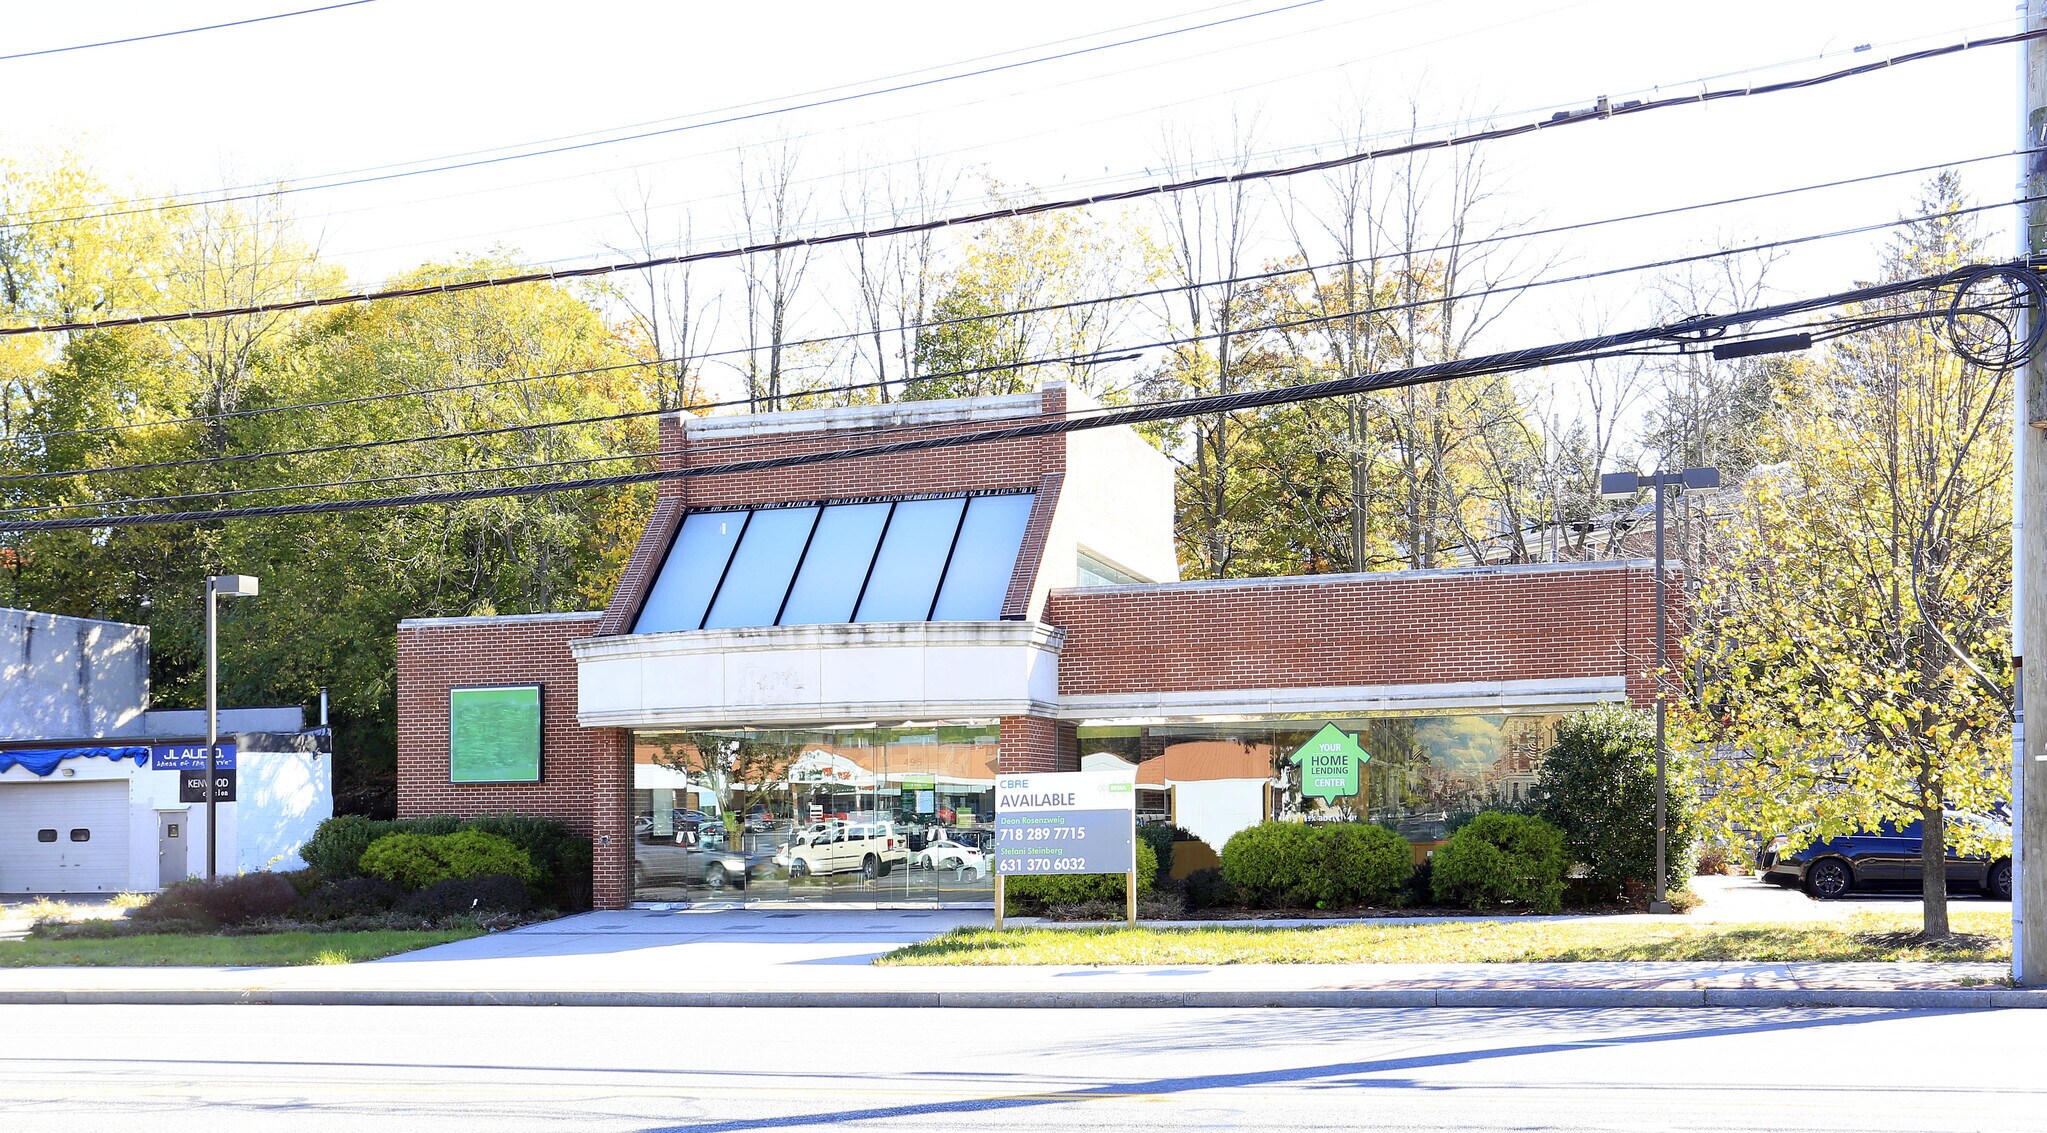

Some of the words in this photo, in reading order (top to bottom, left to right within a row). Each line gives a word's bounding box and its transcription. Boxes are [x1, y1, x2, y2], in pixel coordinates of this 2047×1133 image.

[1319, 743, 1341, 752] YOUR
[163, 748, 179, 760] JL
[1311, 755, 1348, 766] HOME
[1311, 766, 1348, 775] LENDING
[999, 779, 1029, 789] CBRE
[1314, 778, 1346, 787] CENTER
[1000, 792, 1076, 808] AVAILABLE
[1000, 816, 1021, 825] Dean
[1022, 815, 1065, 825] Rosenzweig
[999, 828, 1024, 841] 718
[1026, 827, 1051, 841] 289
[1053, 826, 1086, 840] 7715
[1000, 847, 1026, 855] Stefani
[1027, 846, 1063, 856] Steinberg
[999, 859, 1022, 872] 631
[1026, 858, 1051, 871] 370
[1053, 857, 1086, 871] 6032
